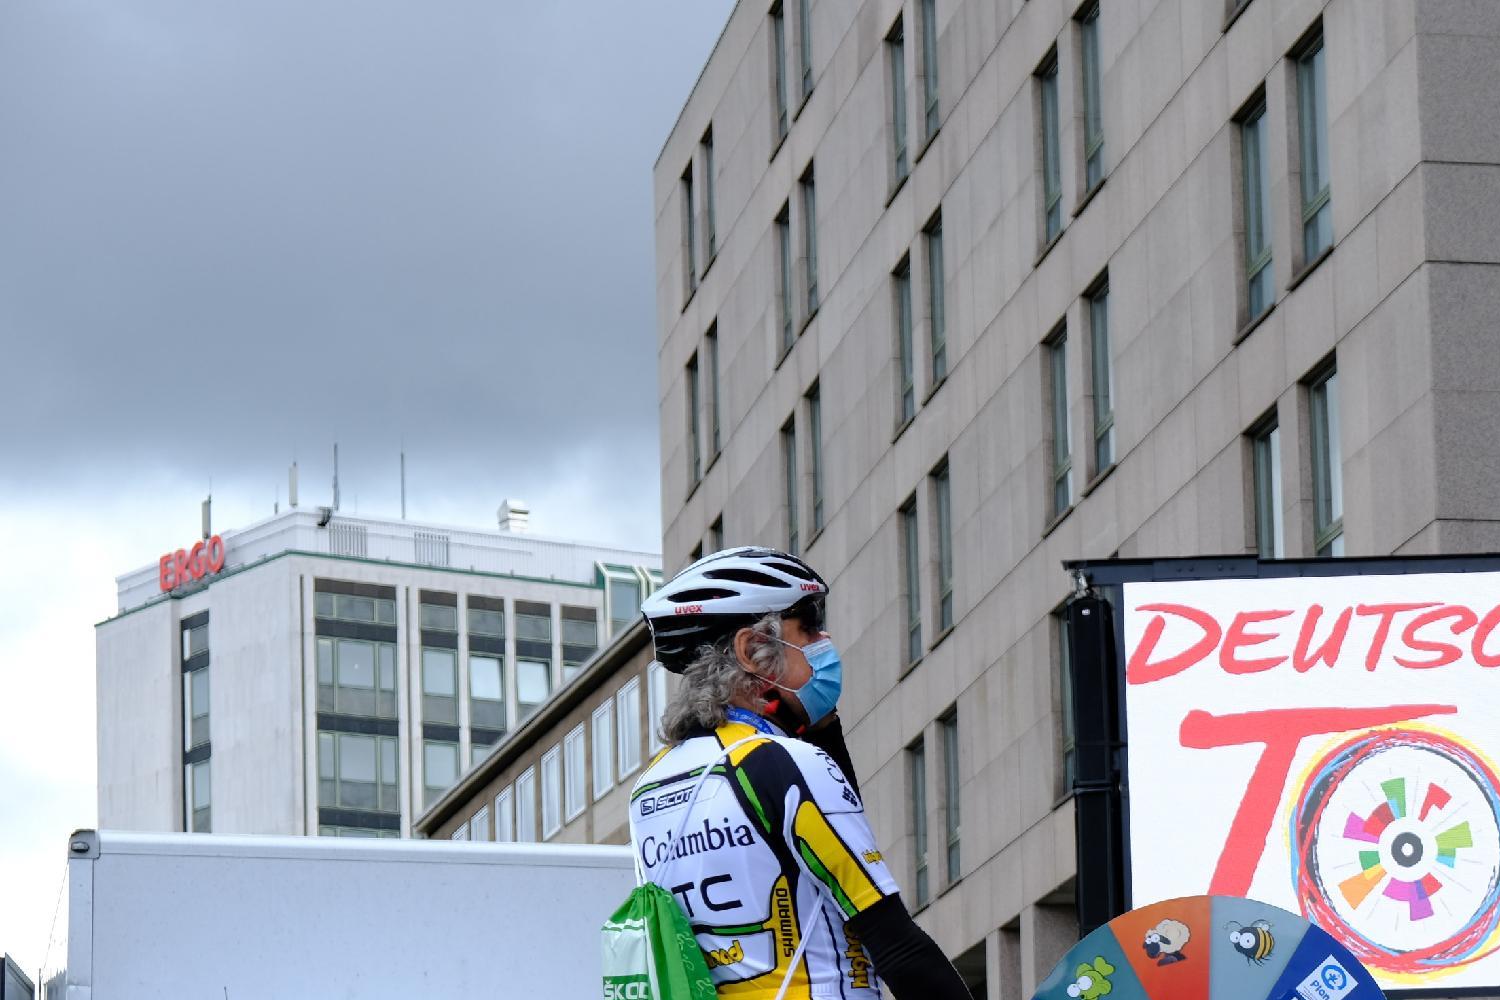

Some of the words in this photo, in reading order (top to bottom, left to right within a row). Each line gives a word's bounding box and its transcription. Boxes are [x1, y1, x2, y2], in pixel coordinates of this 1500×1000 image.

[159, 534, 225, 592] ERGO
[800, 582, 820, 592] uvex
[674, 603, 703, 615] uvex
[641, 817, 756, 869] Columbia
[782, 887, 798, 958] SHIMANO
